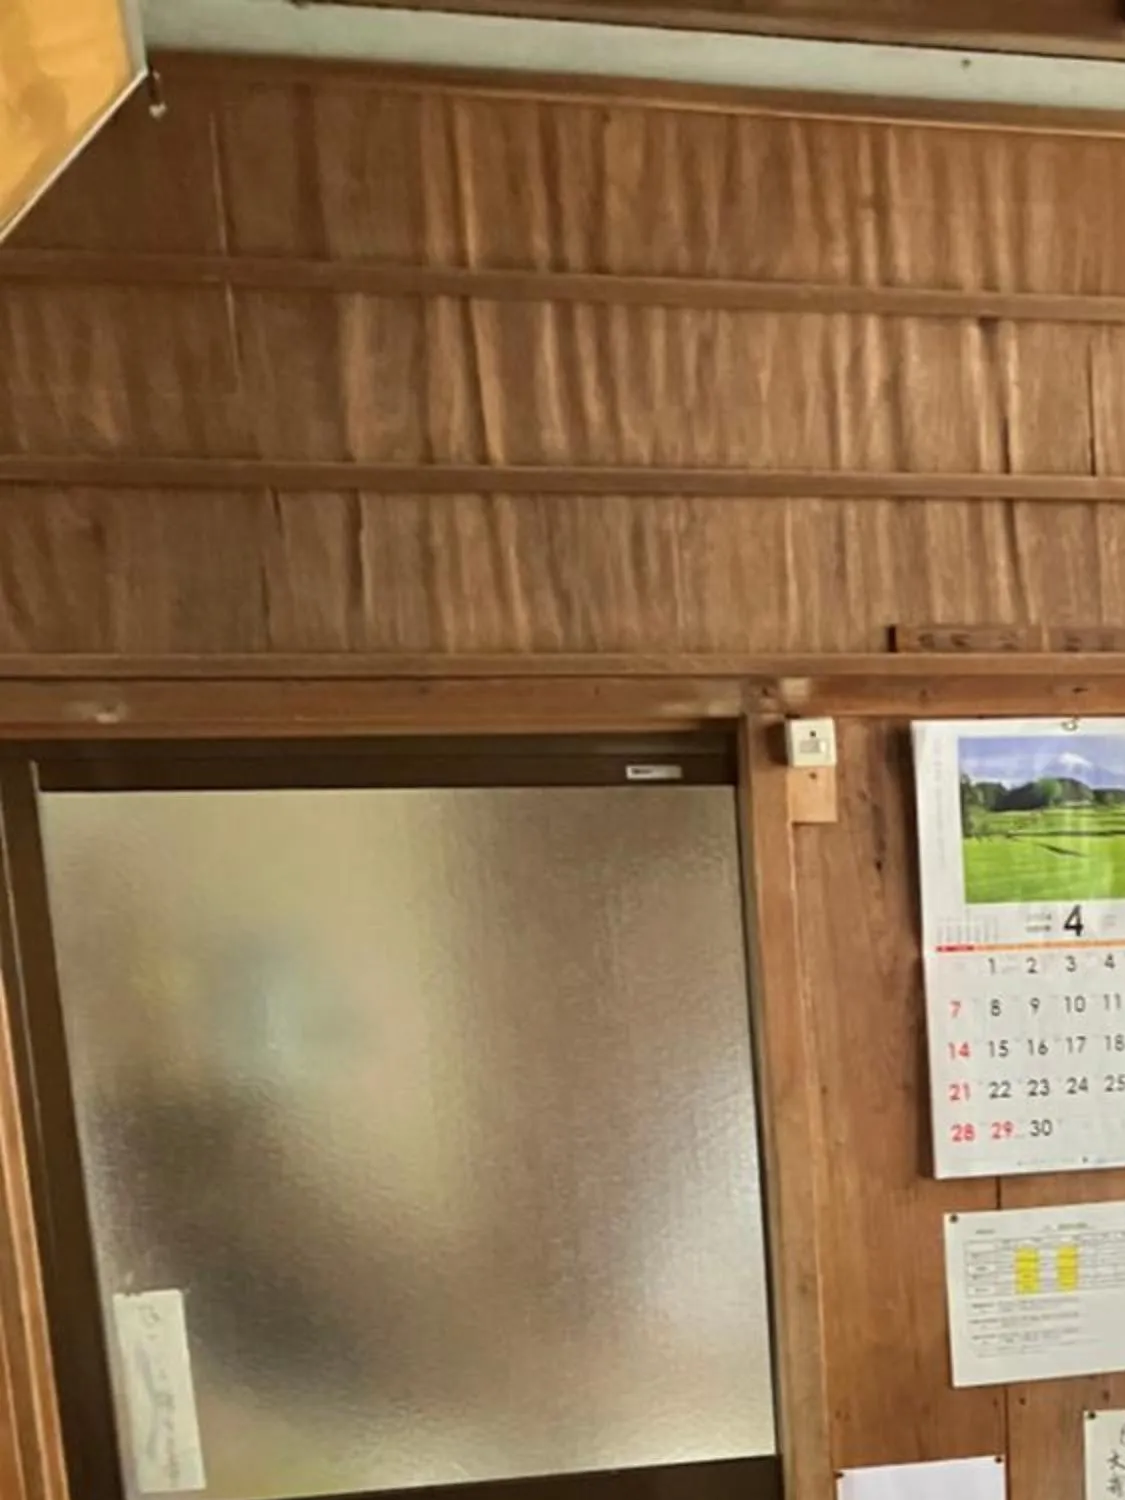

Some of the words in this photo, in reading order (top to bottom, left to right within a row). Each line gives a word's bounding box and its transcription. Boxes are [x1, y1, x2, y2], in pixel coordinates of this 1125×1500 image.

[1063, 903, 1085, 937] 4
[989, 958, 997, 975] 1
[1028, 958, 1038, 975] 2
[1066, 956, 1078, 974] 3
[1104, 953, 1117, 971] 4
[950, 1000, 963, 1018] 7
[991, 1000, 1002, 1018] 8
[1030, 997, 1041, 1015] 9
[1065, 996, 1087, 1015] 10
[1104, 994, 1123, 1011] 11
[950, 1043, 971, 1059] 14
[990, 1040, 1010, 1059] 15
[1028, 1040, 1050, 1057] 16
[1067, 1036, 1088, 1053] 17
[1106, 1035, 1125, 1053] 18
[950, 1084, 971, 1103] 21
[990, 1081, 1012, 1101] 22
[1028, 1079, 1051, 1098] 23
[1068, 1077, 1090, 1096] 24
[952, 1124, 976, 1144] 28
[992, 1121, 1014, 1141] 29
[1031, 1119, 1054, 1138] 30
